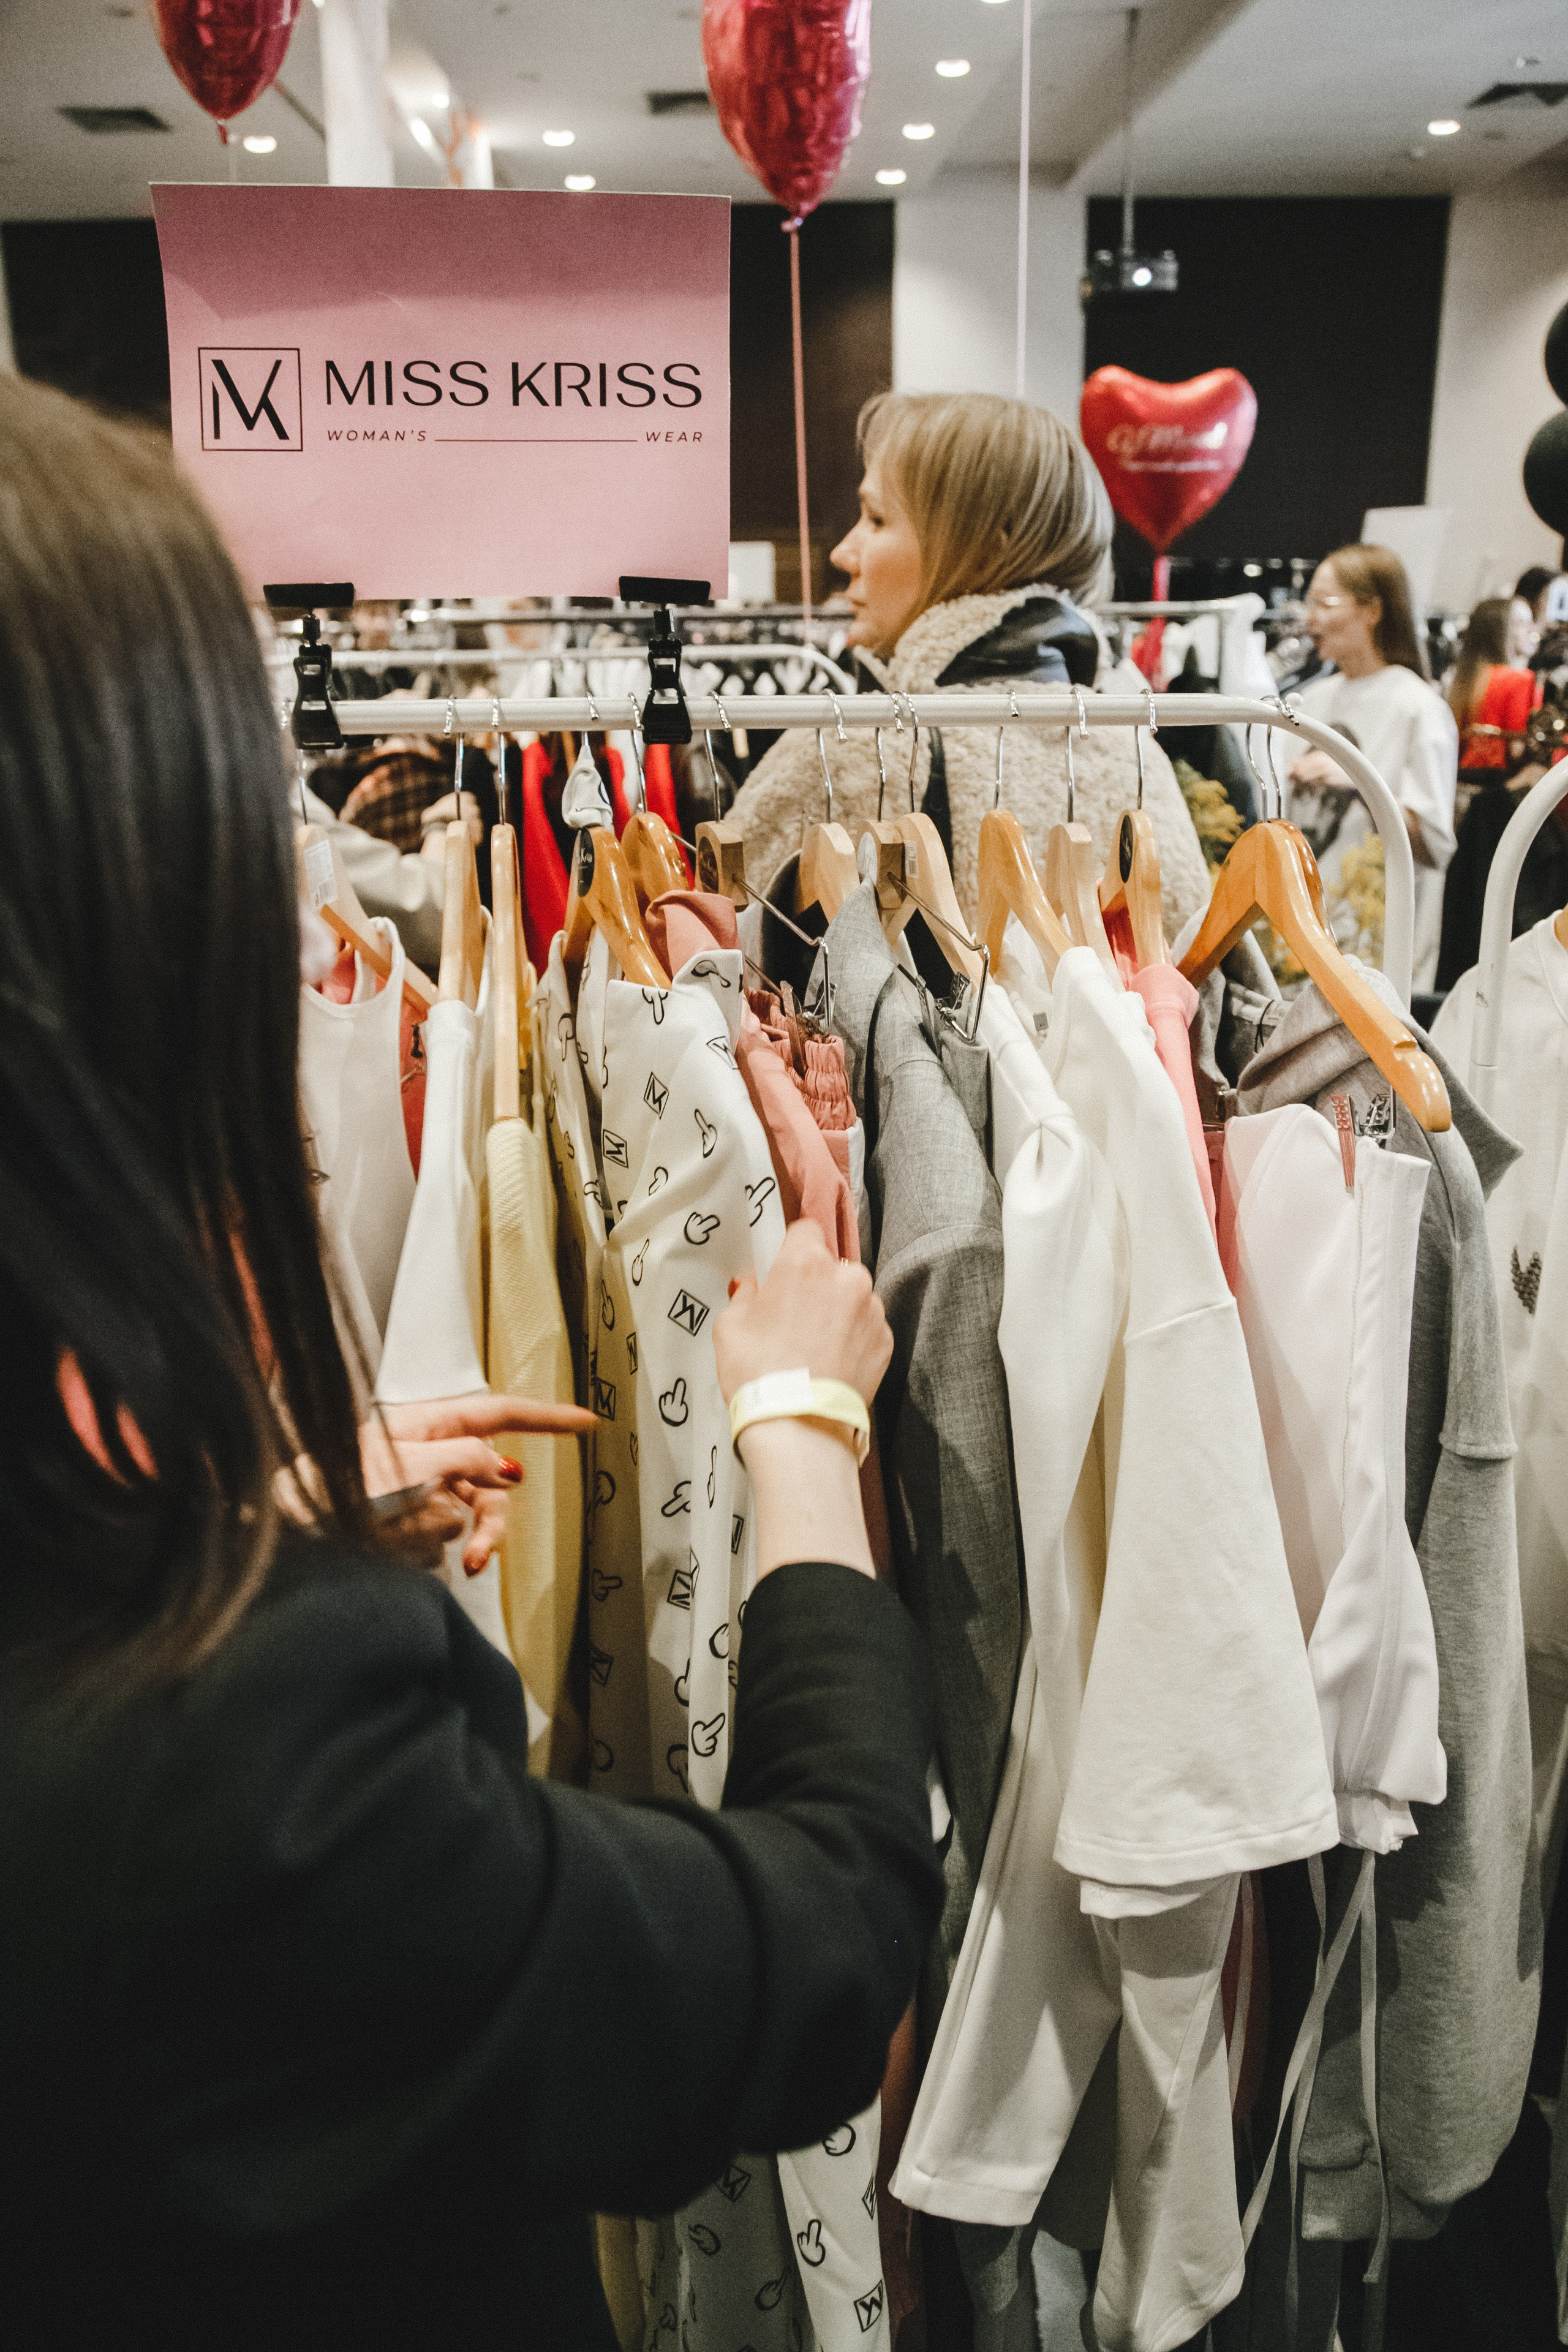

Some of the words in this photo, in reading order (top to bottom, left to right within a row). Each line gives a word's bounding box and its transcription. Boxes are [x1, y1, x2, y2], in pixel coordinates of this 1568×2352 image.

[325, 360, 489, 407] MISS
[511, 361, 703, 409] KRISS
[327, 429, 428, 442] WOMAN'S
[645, 431, 704, 443] WEAR
